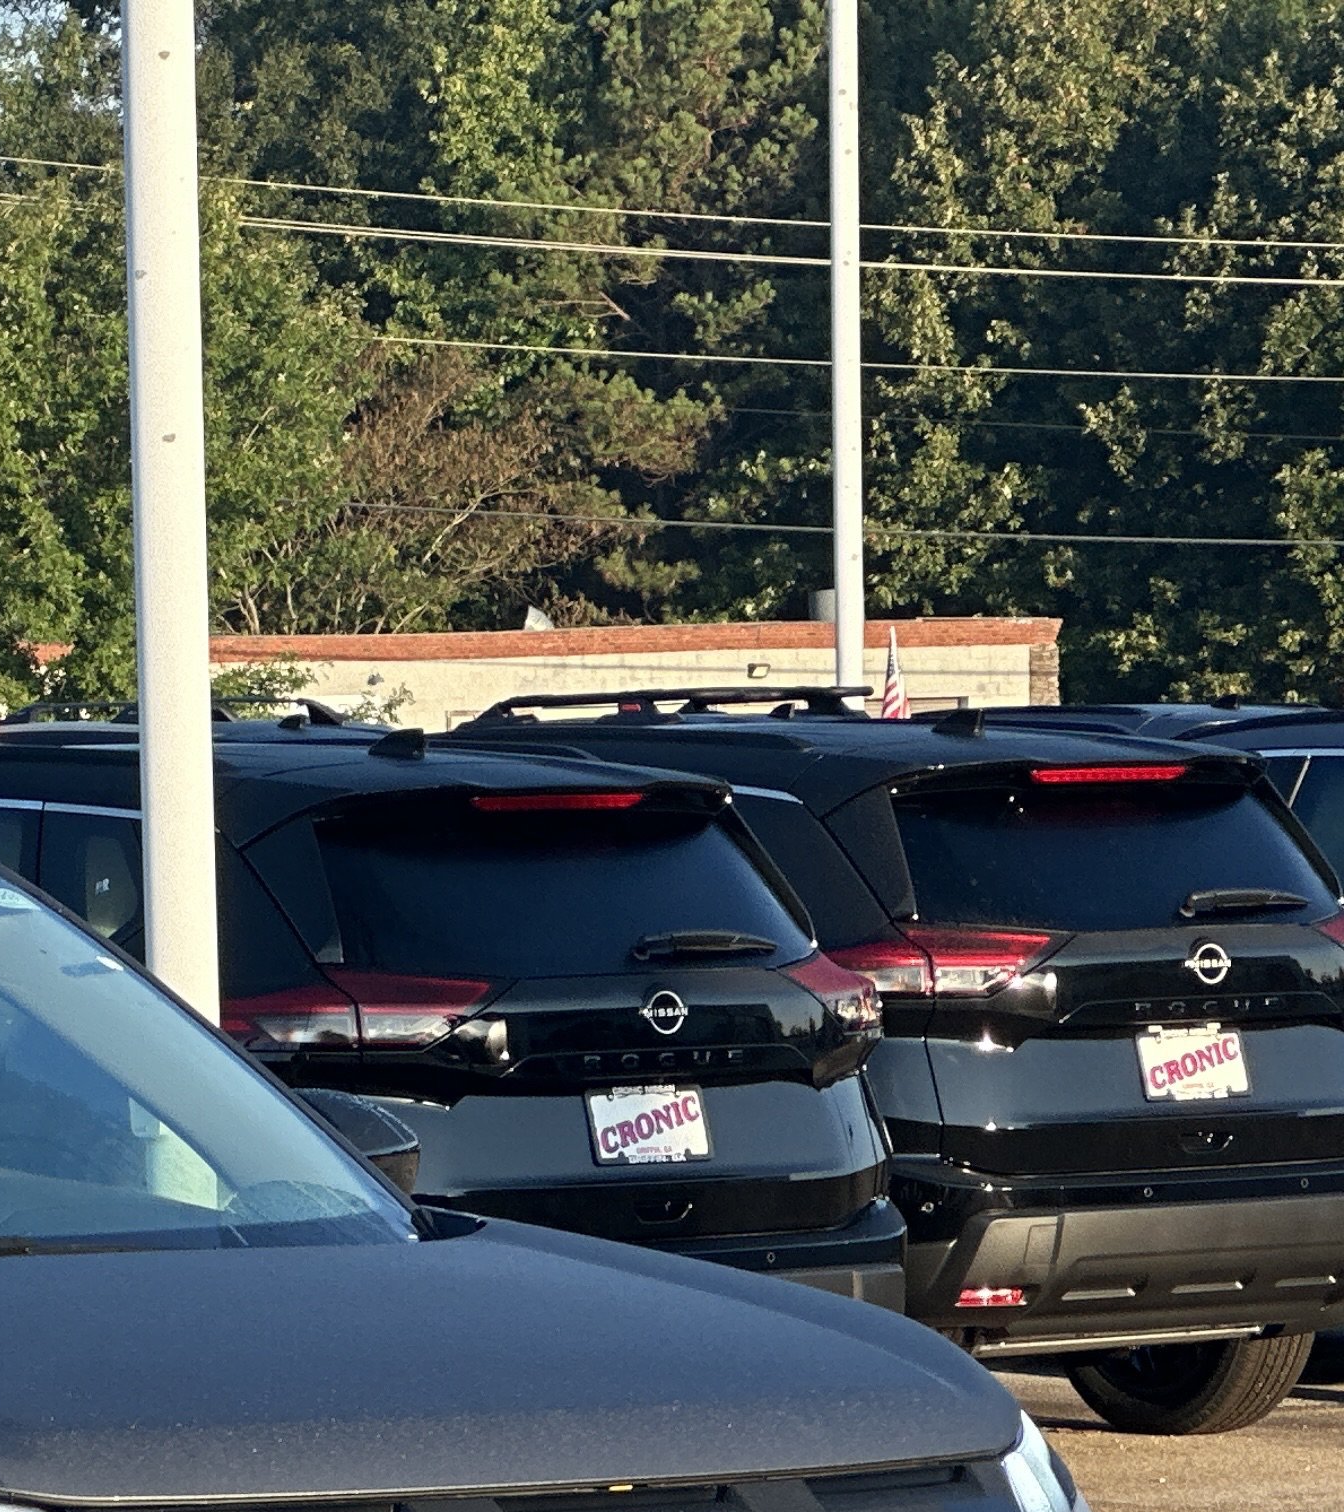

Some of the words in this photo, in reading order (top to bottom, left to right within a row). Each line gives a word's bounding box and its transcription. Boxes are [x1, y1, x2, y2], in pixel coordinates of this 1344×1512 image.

[645, 1006, 689, 1018] NISSAN
[1149, 1037, 1239, 1089] CRONIC
[600, 1096, 699, 1153] CRONIC
